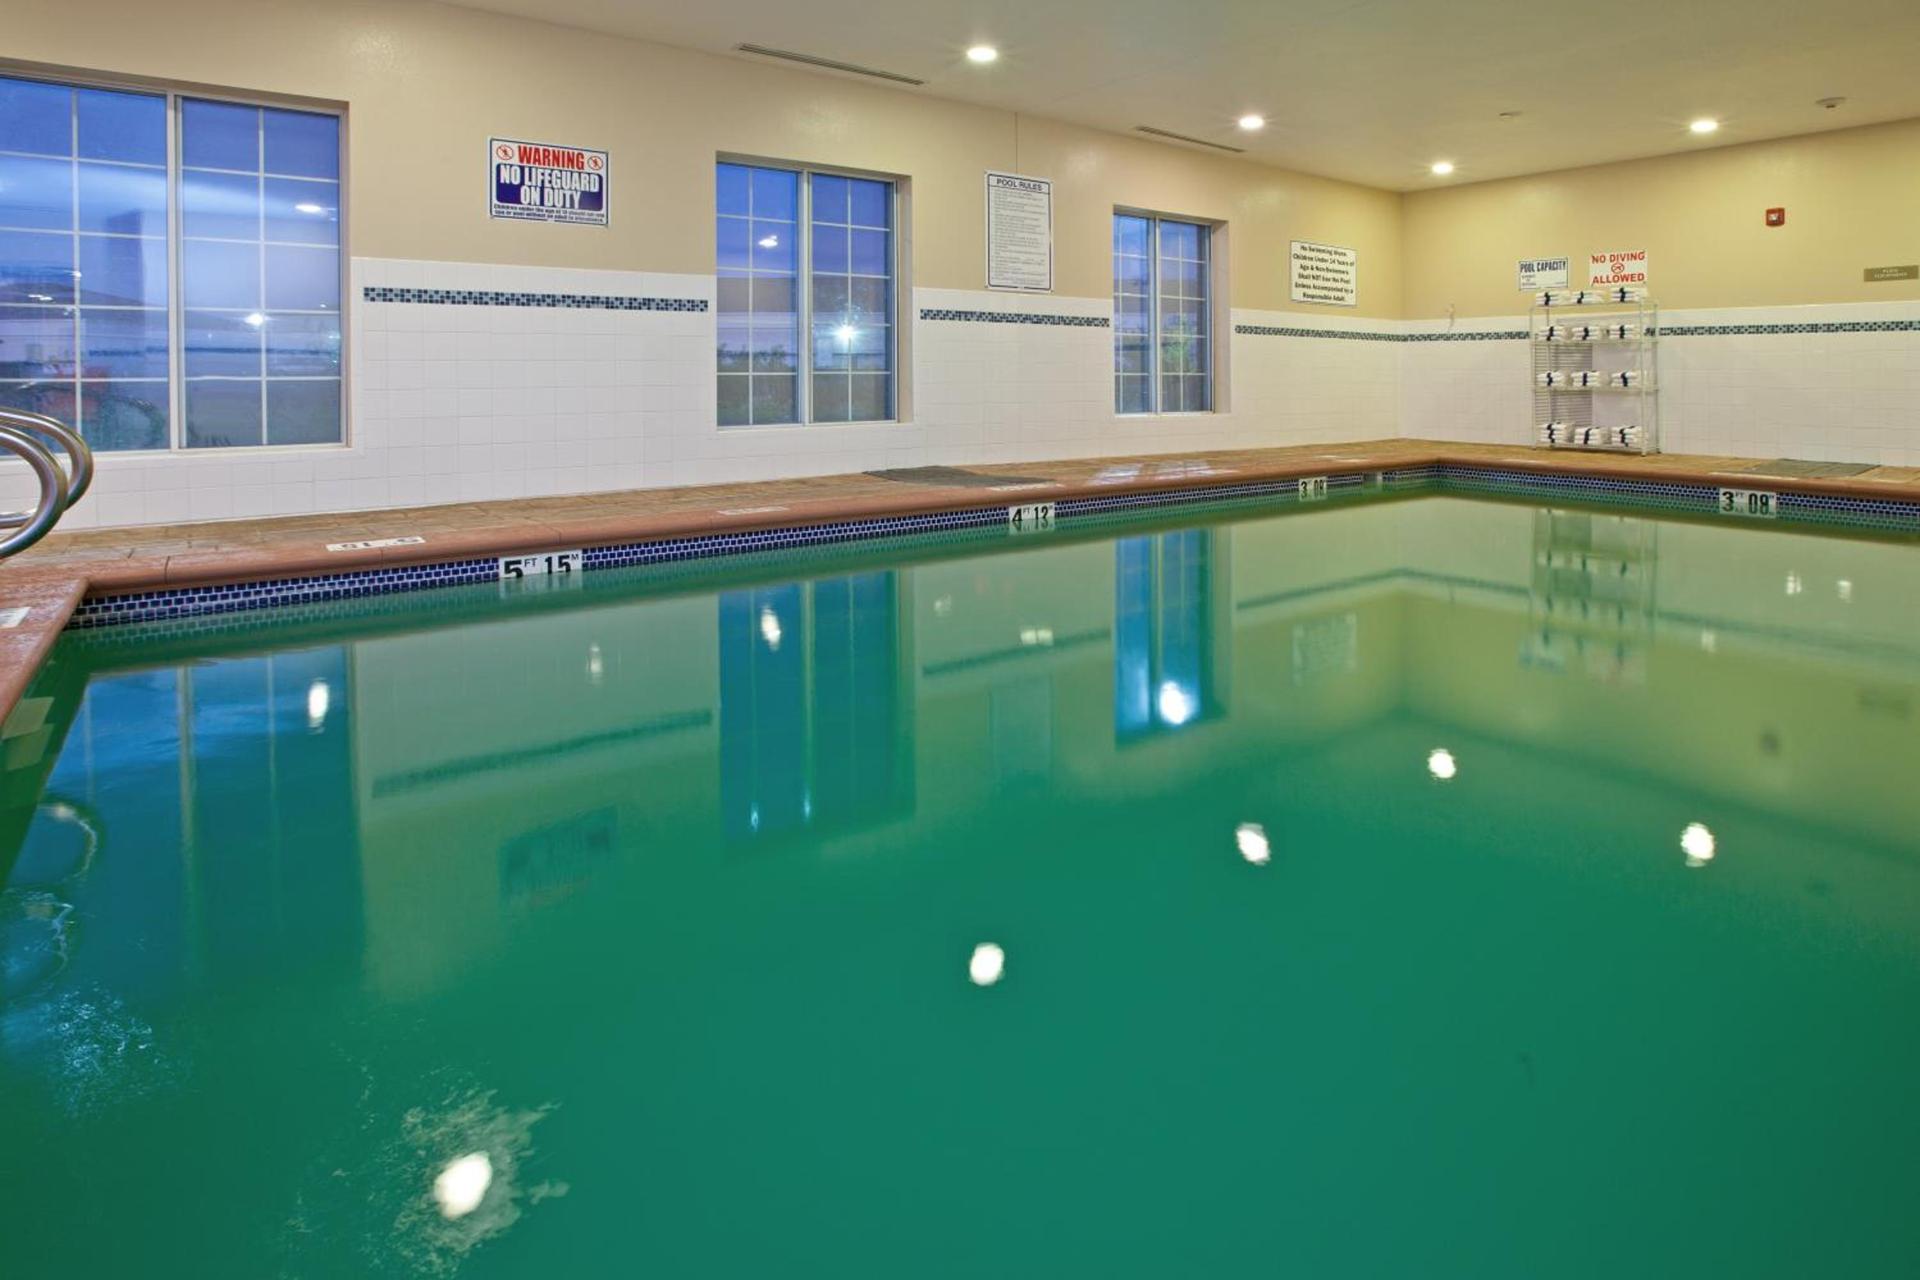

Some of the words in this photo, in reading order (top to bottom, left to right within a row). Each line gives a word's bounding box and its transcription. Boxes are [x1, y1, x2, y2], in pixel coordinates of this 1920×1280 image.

[518, 145, 585, 170] WARNING
[500, 165, 521, 185] NO
[524, 167, 600, 192] LIFEGUARD
[996, 177, 1017, 187] POOL
[1019, 181, 1043, 191] RULES
[520, 185, 540, 206] ON
[543, 188, 581, 209] DUTY
[1592, 254, 1606, 264] NO
[1610, 251, 1645, 262] DIVING
[1520, 263, 1535, 273] POOL
[1537, 260, 1566, 272] CAPACITY
[1592, 272, 1645, 284] ALLOWED
